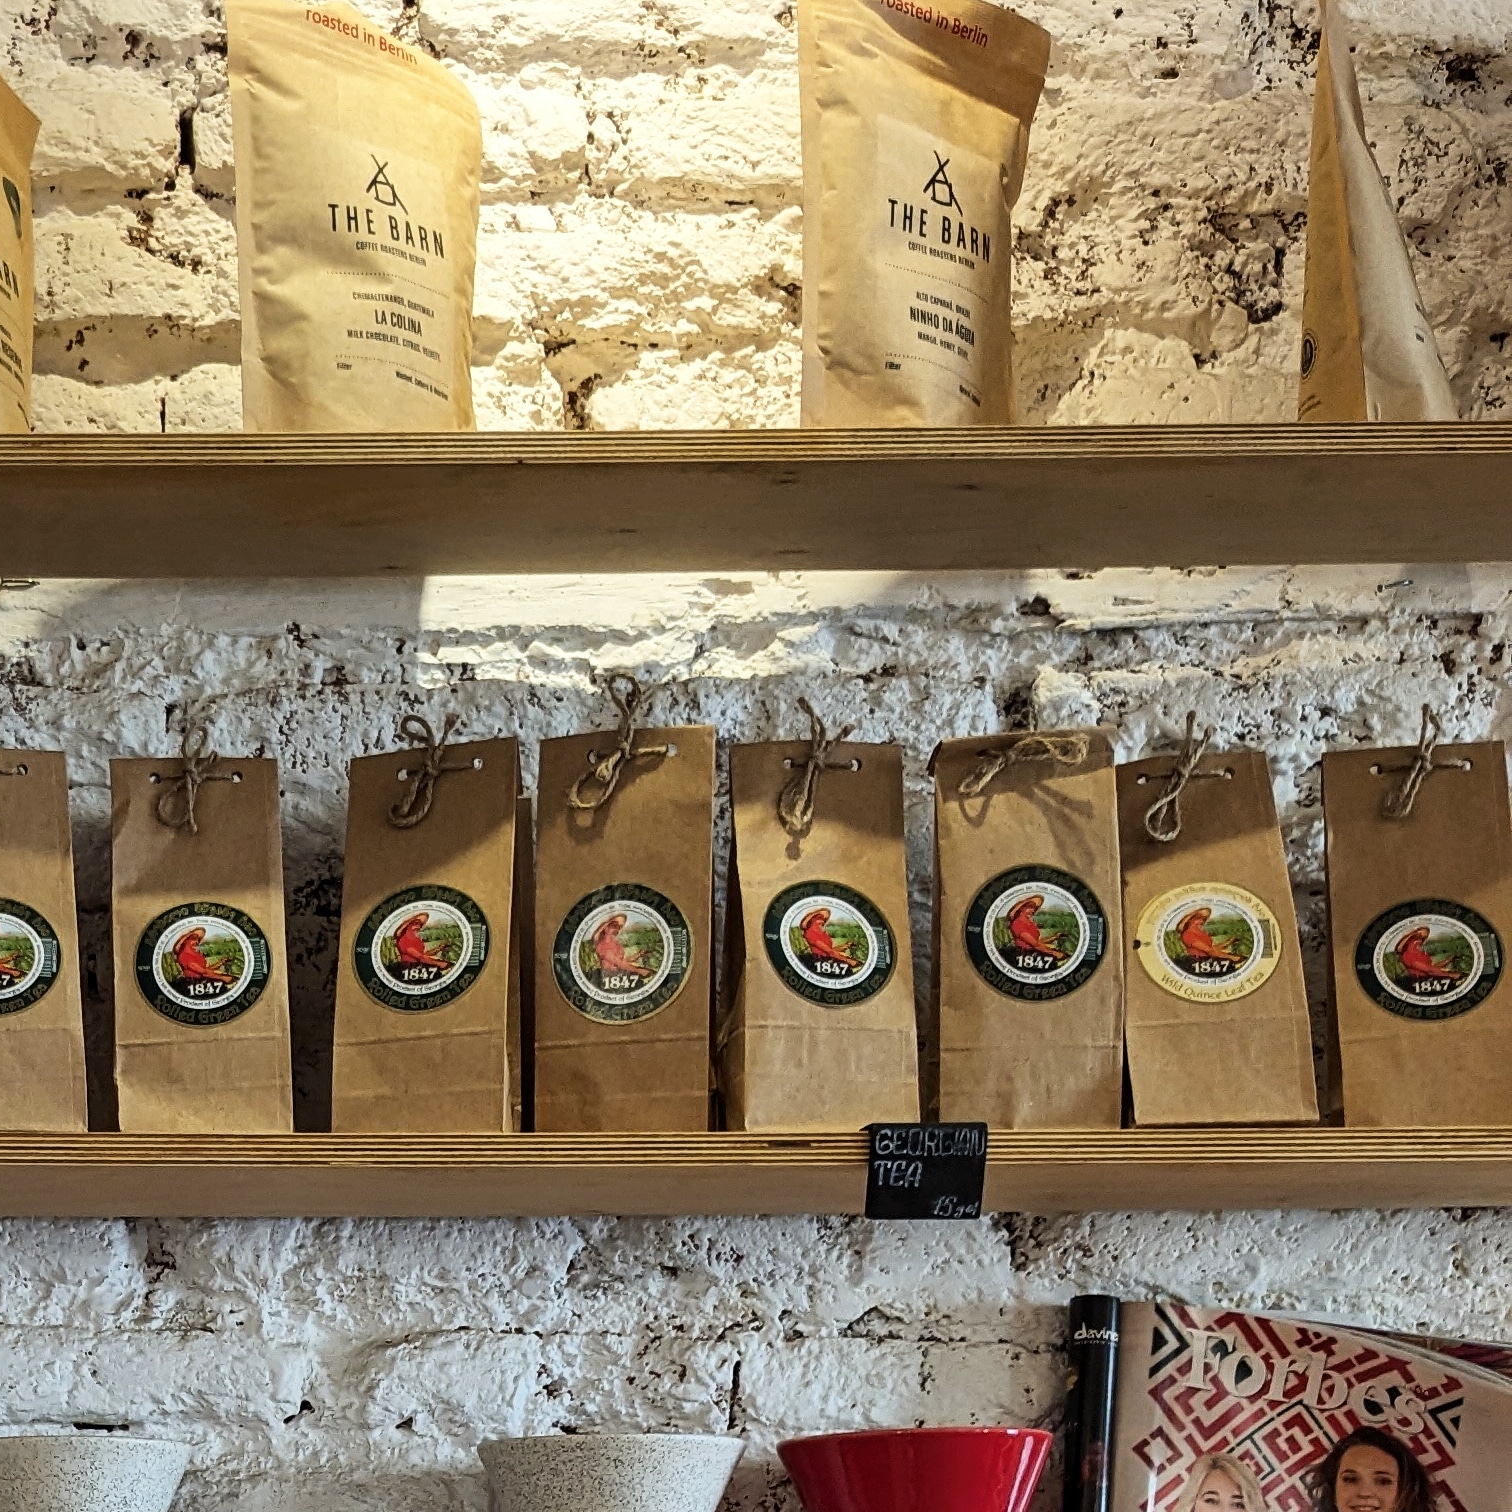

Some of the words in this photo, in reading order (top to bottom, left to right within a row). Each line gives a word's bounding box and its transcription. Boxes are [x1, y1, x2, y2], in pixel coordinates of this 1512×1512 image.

[305, 9, 359, 39] roasted
[363, 28, 375, 47] in
[379, 36, 418, 65] Berlin
[936, 11, 948, 30] in
[951, 18, 988, 48] Berlin
[328, 203, 376, 236] THE
[388, 214, 445, 259] BARN
[888, 198, 928, 238] THE
[941, 215, 990, 264] BARN
[374, 309, 388, 326] LA
[390, 311, 423, 337] COLINA
[909, 306, 940, 330] NINHO
[942, 316, 954, 335] DA
[814, 960, 849, 975] 1847
[1016, 955, 1054, 969] 1847
[1191, 960, 1231, 975] 1847
[402, 966, 438, 981] 1847
[602, 975, 639, 990] 1847
[1245, 971, 1265, 986] Tea
[187, 981, 223, 996] 1847
[1412, 979, 1451, 994] 1847
[874, 1160, 923, 1188] TEA
[1183, 1327, 1428, 1436] Forbes
